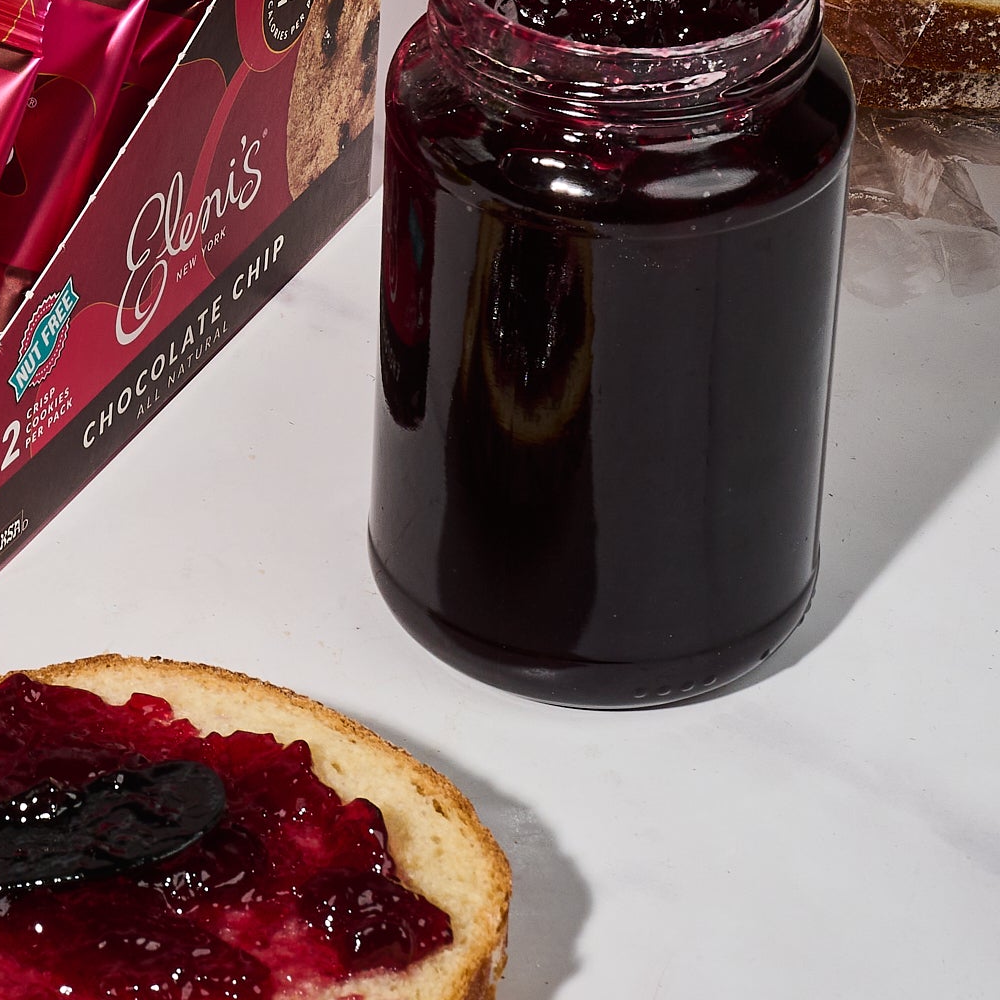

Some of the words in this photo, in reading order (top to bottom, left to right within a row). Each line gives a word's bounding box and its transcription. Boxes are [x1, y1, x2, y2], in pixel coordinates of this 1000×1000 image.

[268, 0, 289, 41] CALORIES
[290, 12, 306, 36] PER
[176, 254, 198, 282] NEW
[201, 226, 227, 254] YORK
[16, 340, 41, 389] NUT
[41, 290, 74, 347] FREE
[82, 294, 222, 448] CHOCOLATE
[232, 234, 285, 300] CHIP
[136, 388, 161, 420] ALL
[166, 320, 228, 388] NATURAL
[24, 425, 44, 449] PER
[47, 397, 73, 428] PACK
[26, 386, 56, 419] CRISP
[26, 388, 70, 434] COOKIES
[0, 419, 21, 471] 2
